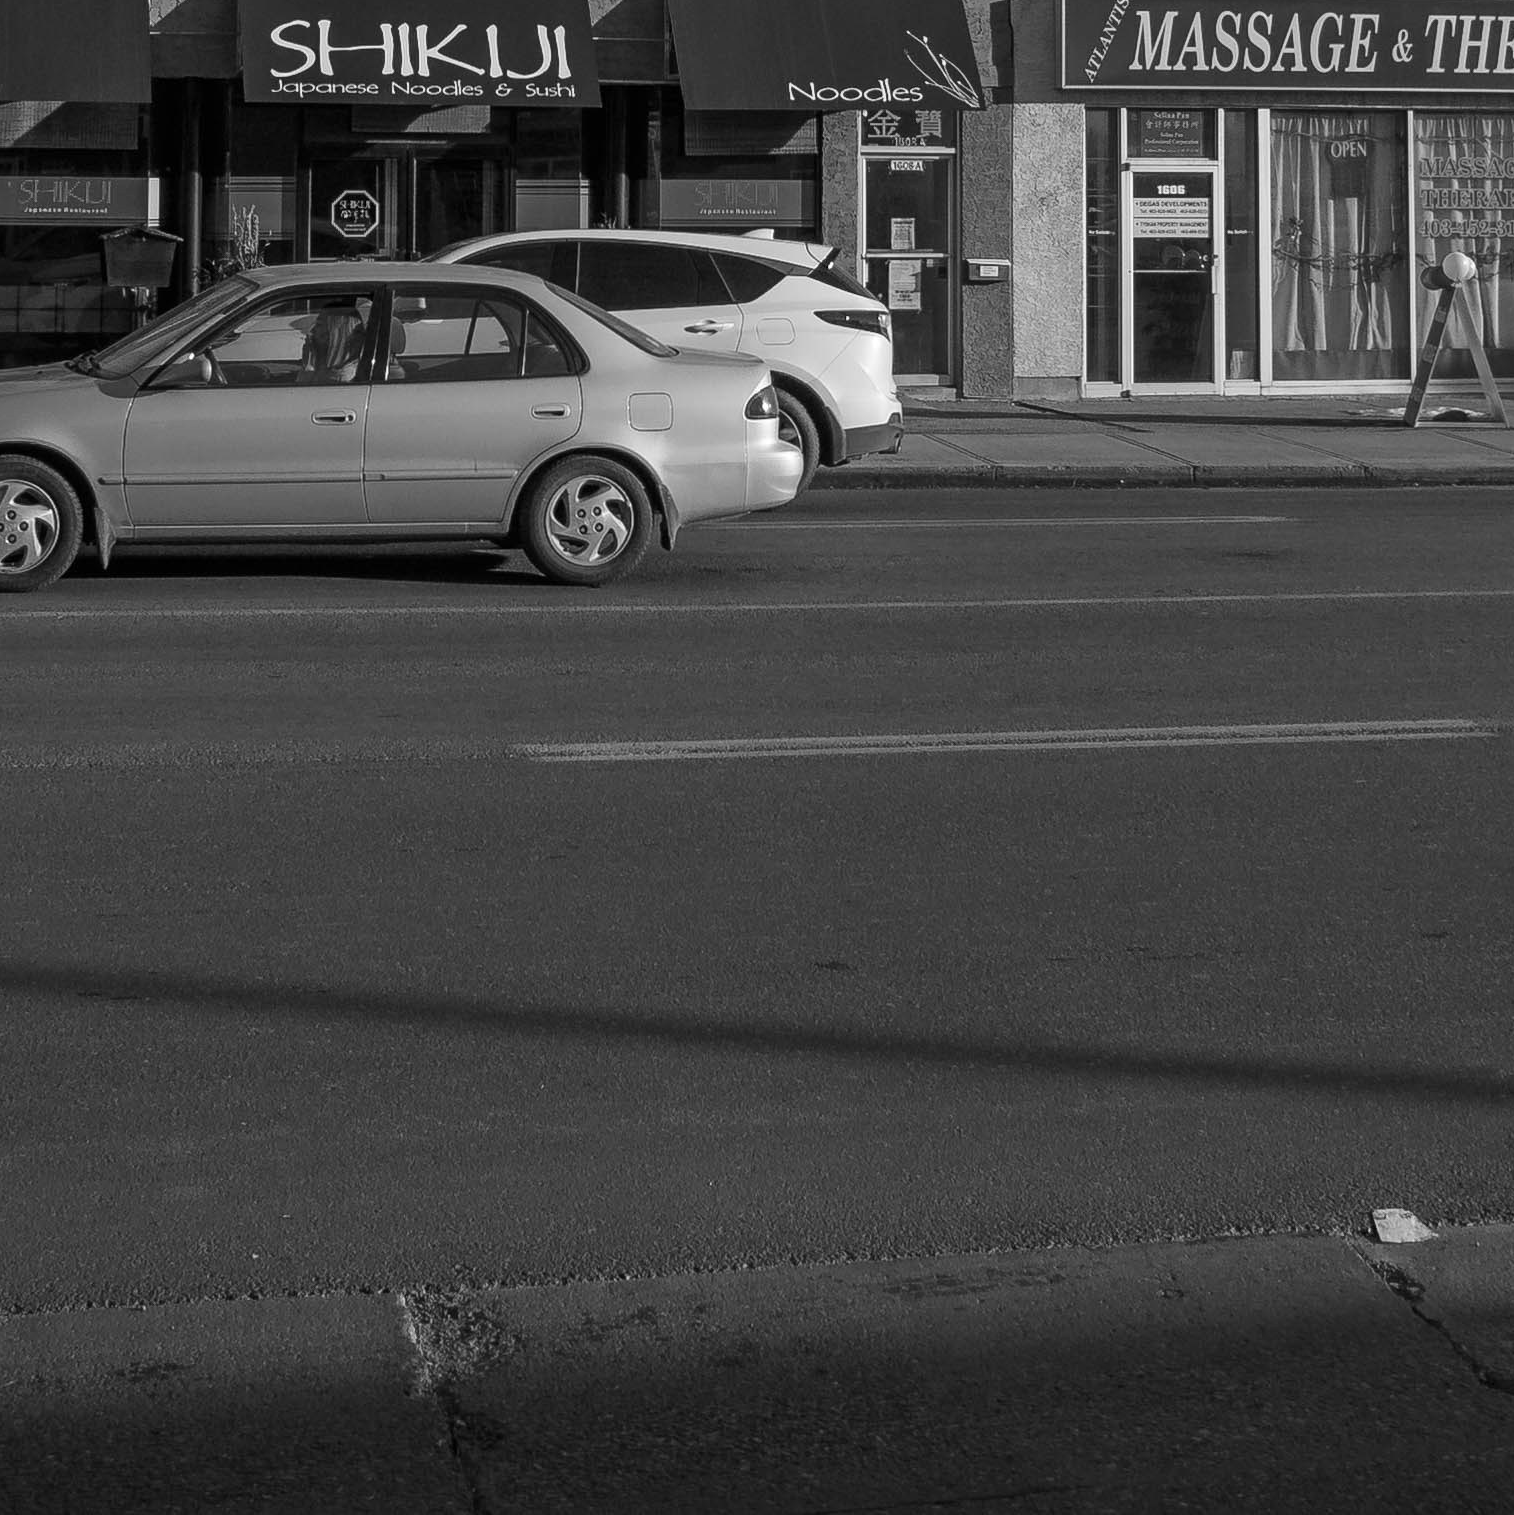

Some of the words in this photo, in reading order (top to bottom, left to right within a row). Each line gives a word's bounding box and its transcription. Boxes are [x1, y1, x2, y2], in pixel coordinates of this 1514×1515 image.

[270, 20, 572, 80] SHIKIJI
[1129, 10, 1381, 74] MASSAGE
[1393, 28, 1414, 63] &
[271, 79, 379, 98] Japanese
[391, 80, 483, 97] Noodles
[495, 84, 513, 97] &
[525, 82, 575, 98] Sushi
[788, 78, 923, 102] Noodles
[1331, 141, 1367, 159] OPEN
[1157, 185, 1185, 195] 1606
